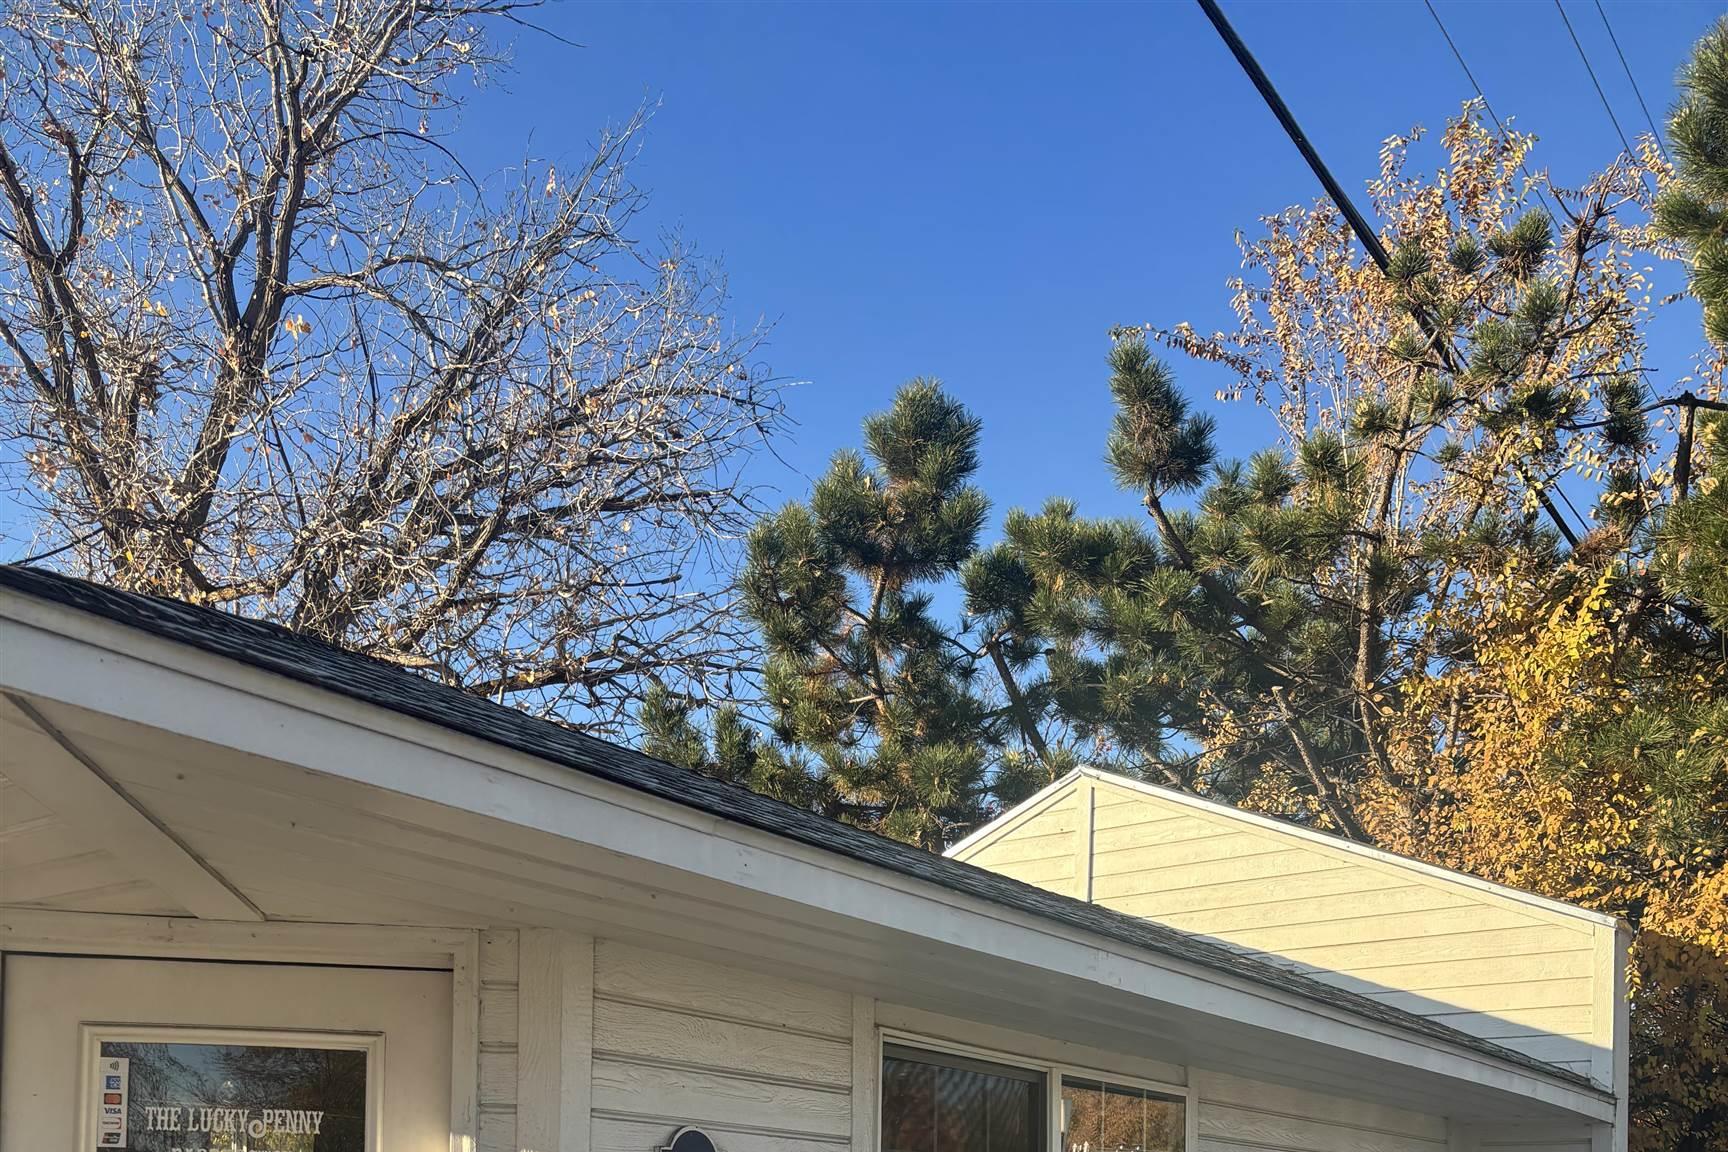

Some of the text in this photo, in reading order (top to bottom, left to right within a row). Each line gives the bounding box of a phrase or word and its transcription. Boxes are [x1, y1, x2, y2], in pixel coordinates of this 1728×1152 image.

[104, 1107, 122, 1115] VISA
[145, 1106, 324, 1138] THE LUCKY PENNY
